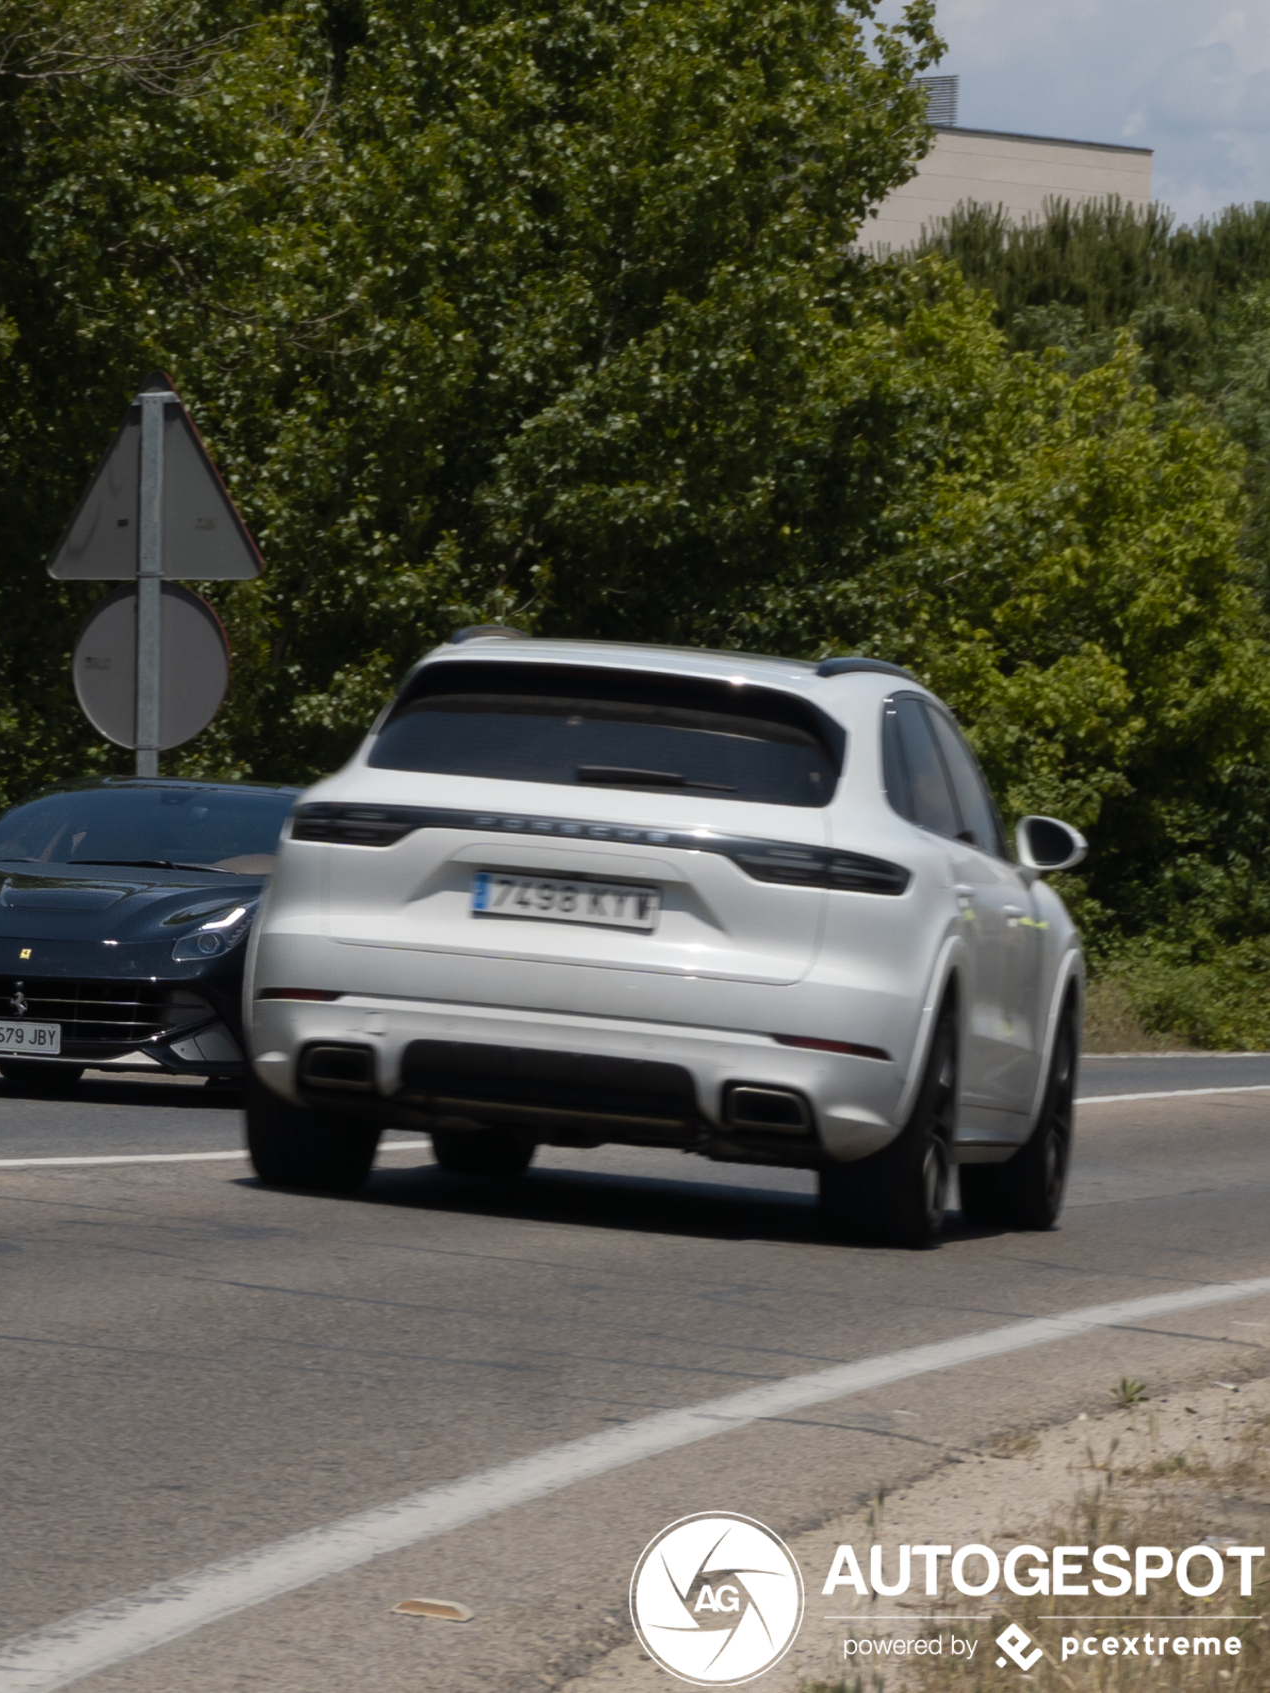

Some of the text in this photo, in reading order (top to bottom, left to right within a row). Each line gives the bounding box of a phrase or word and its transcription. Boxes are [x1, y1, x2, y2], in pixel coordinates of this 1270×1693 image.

[474, 816, 670, 843] PORSCHE
[492, 879, 579, 913] 7498
[28, 1029, 56, 1046] JBY
